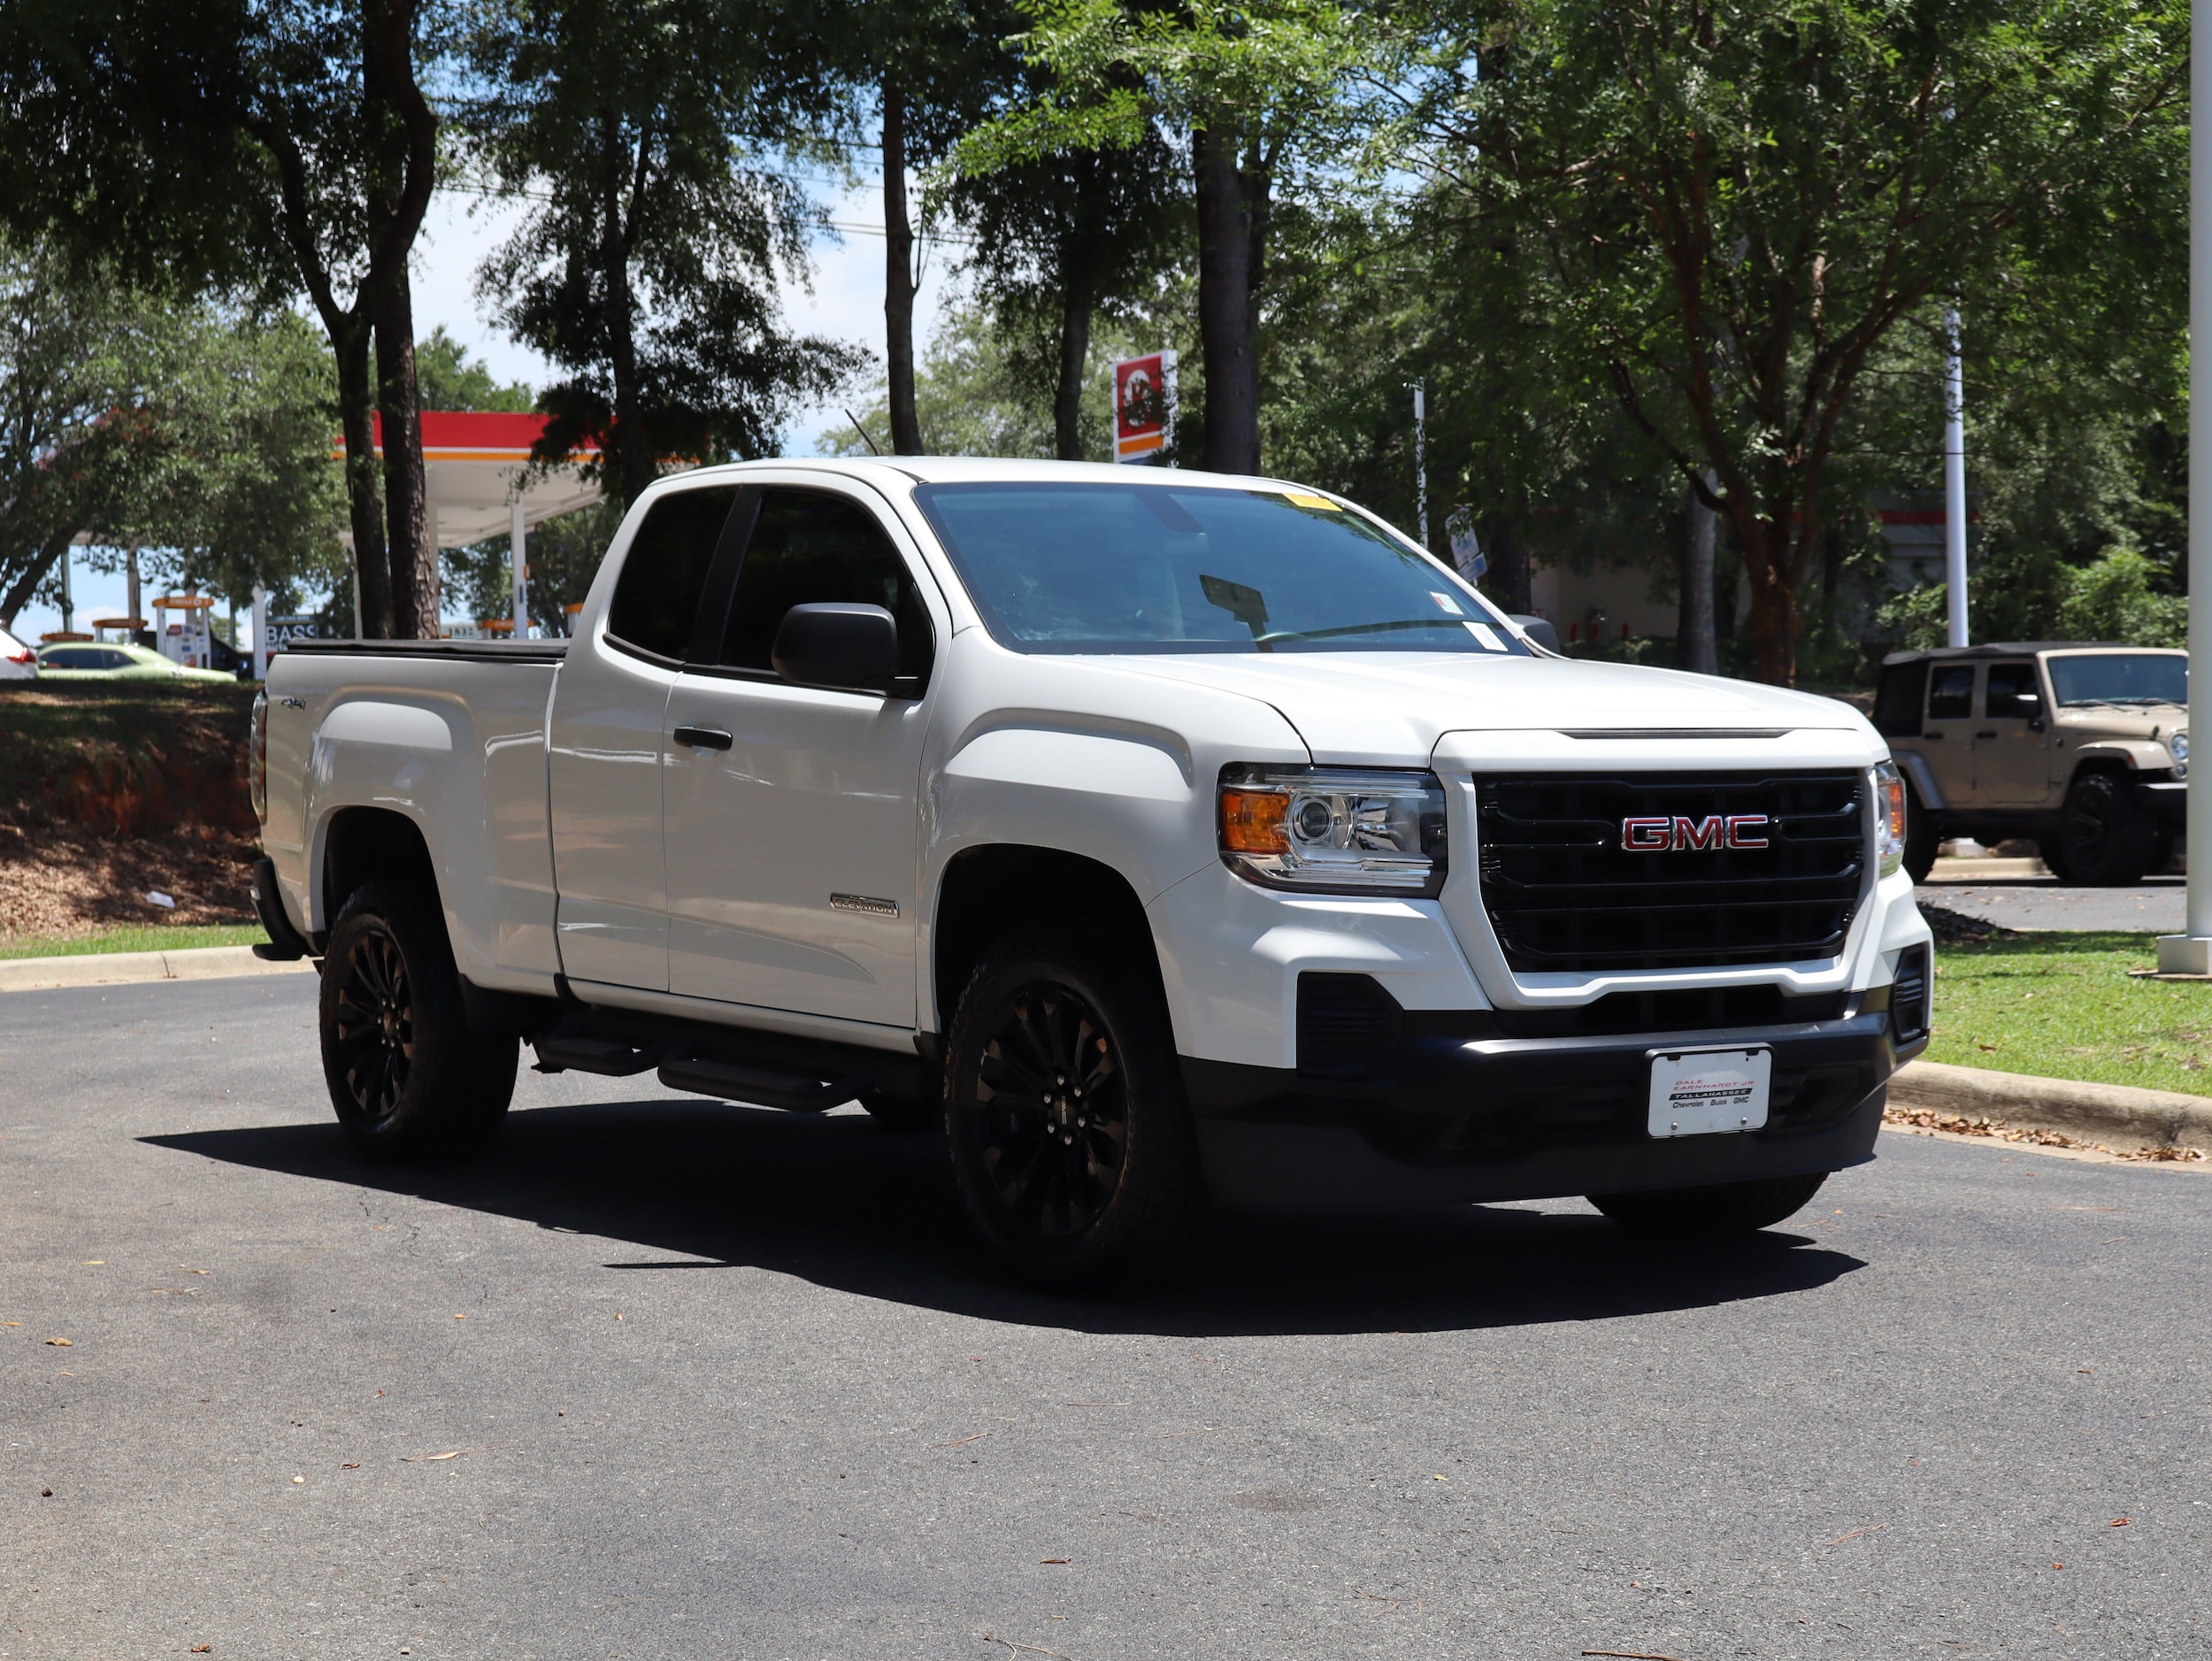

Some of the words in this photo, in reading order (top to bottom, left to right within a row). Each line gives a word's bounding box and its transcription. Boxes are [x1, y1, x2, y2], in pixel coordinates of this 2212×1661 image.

[1621, 814, 1769, 852] GMC
[1673, 1082, 1739, 1091] EARNHARDT
[1674, 1088, 1748, 1099] TALLAHASSEE
[1672, 1100, 1704, 1109] Chevrolet
